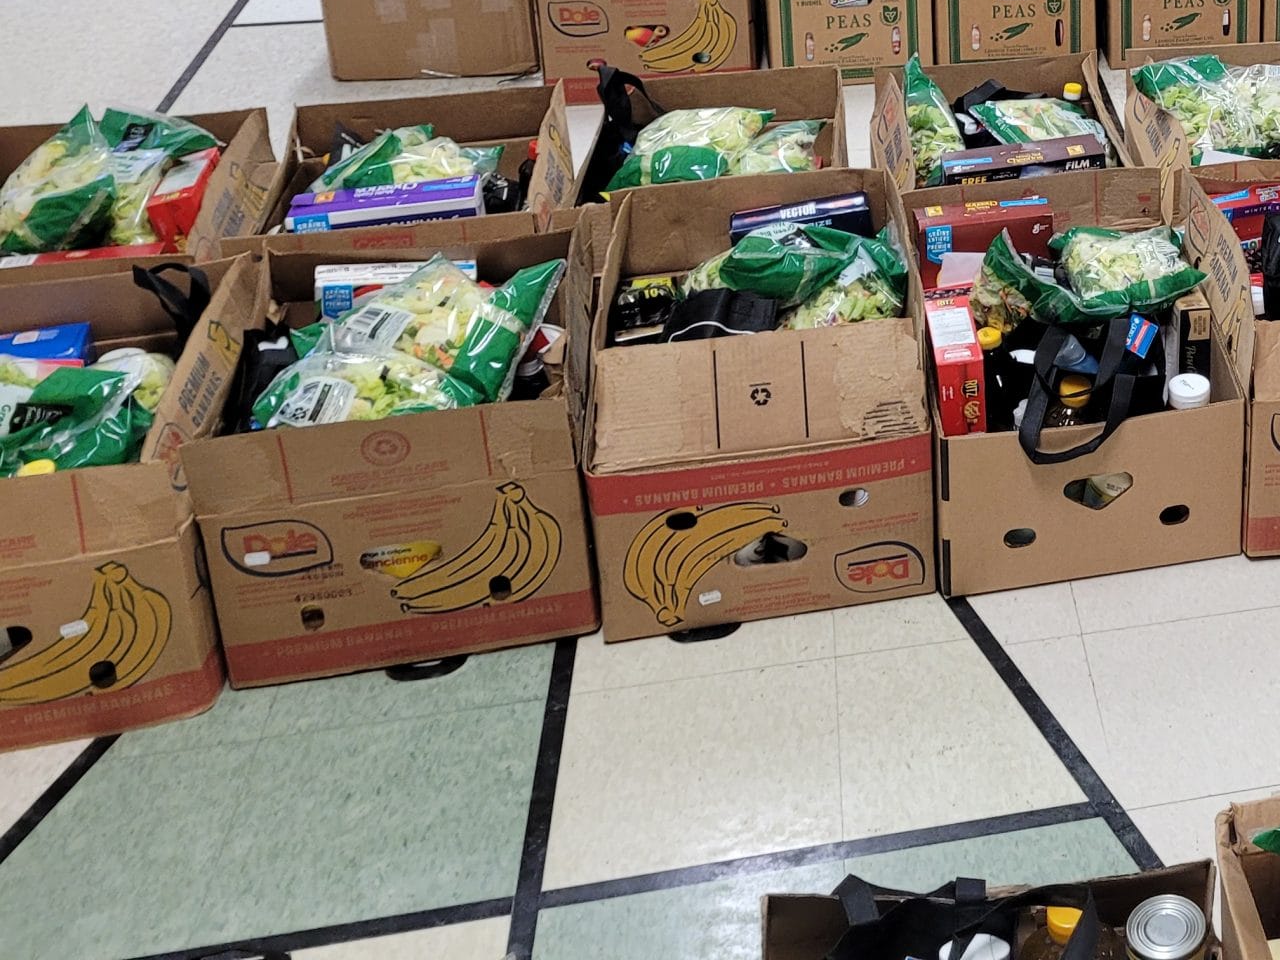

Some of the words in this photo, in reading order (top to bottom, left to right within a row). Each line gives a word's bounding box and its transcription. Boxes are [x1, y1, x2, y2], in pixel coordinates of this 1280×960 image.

[559, 6, 600, 23] Dole
[992, 3, 1036, 19] PEAS
[826, 13, 872, 29] PEAS
[1065, 159, 1090, 171] FILM
[961, 175, 988, 185] FREE
[779, 201, 817, 220] VECTOR
[1244, 204, 1273, 215] WINTER
[177, 351, 211, 415] PREMIUM
[964, 379, 979, 398] RITZ
[782, 469, 845, 488] BANANAS
[846, 458, 906, 482] PREMIUM
[635, 487, 704, 505] BANANAS
[705, 480, 764, 497] PREMIUM
[242, 529, 318, 552] Dole
[847, 558, 910, 585] Dole
[23, 703, 96, 725] PREMIUM
[99, 684, 174, 711] BANANAS
